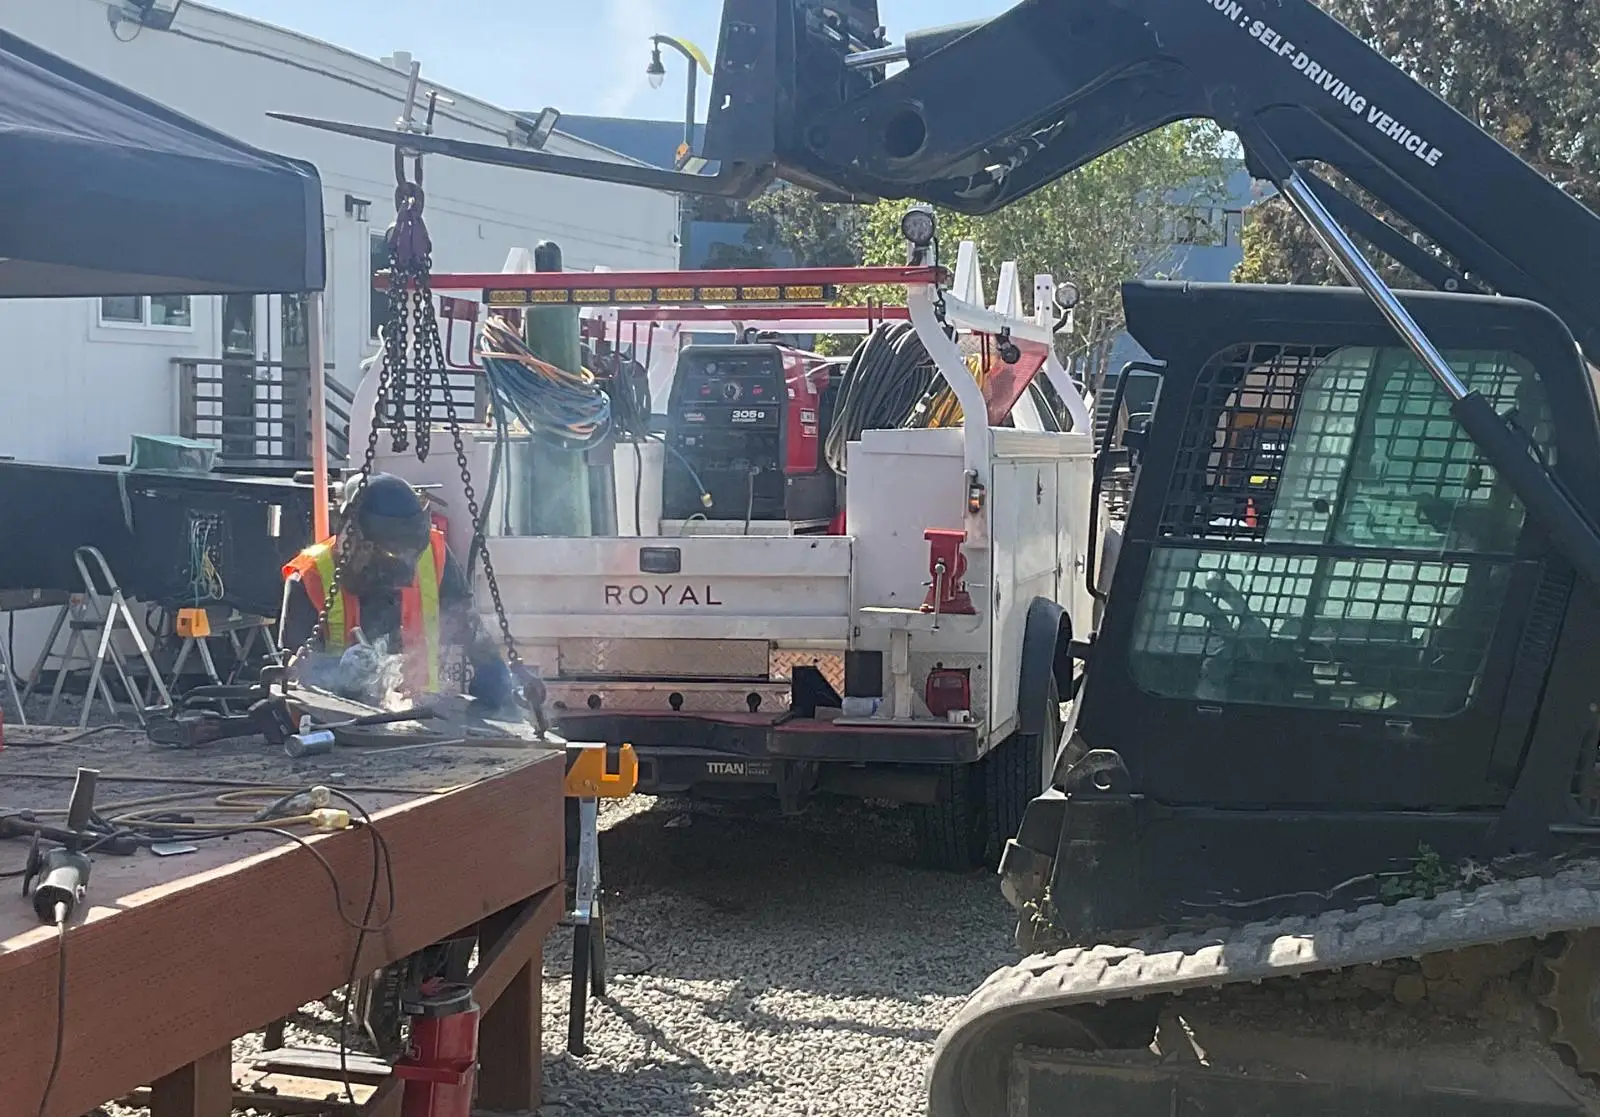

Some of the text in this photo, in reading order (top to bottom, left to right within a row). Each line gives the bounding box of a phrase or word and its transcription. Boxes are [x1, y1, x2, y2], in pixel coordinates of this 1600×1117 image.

[1206, 0, 1243, 21] ON
[1248, 20, 1367, 114] SELF-DRIVING
[1366, 105, 1443, 167] VEHICLE
[604, 584, 723, 605] ROYAL
[706, 761, 744, 775] TITAN
